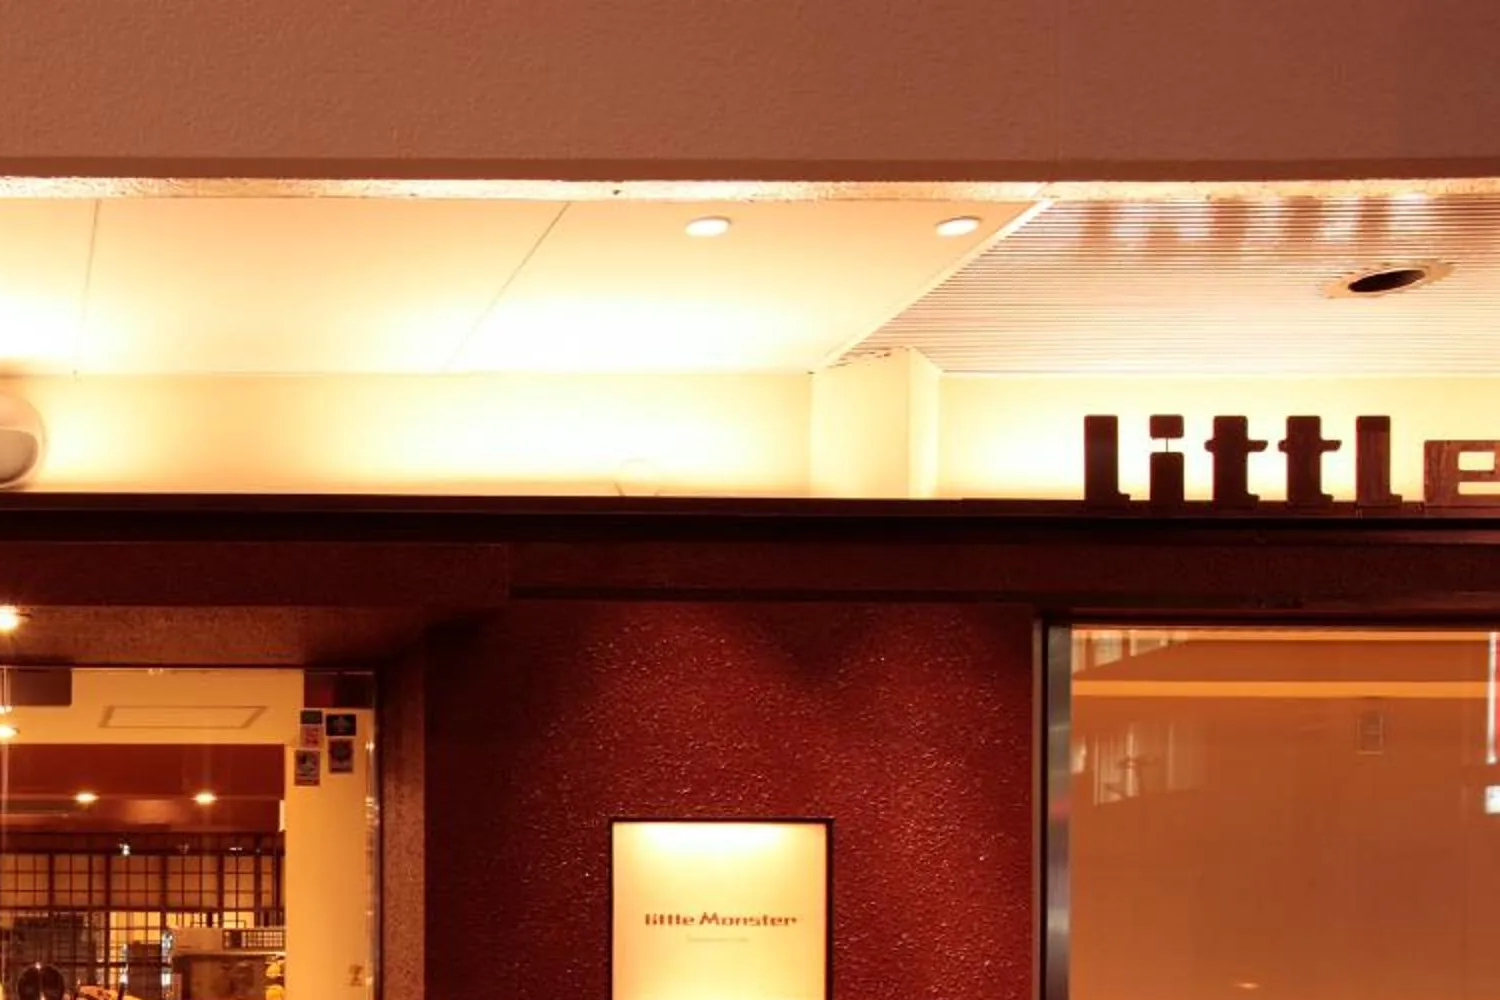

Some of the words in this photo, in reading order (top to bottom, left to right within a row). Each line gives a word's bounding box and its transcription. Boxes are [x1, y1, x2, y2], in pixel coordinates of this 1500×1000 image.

[1084, 415, 1500, 506] little
[645, 913, 694, 926] little
[699, 911, 797, 926] Monster
